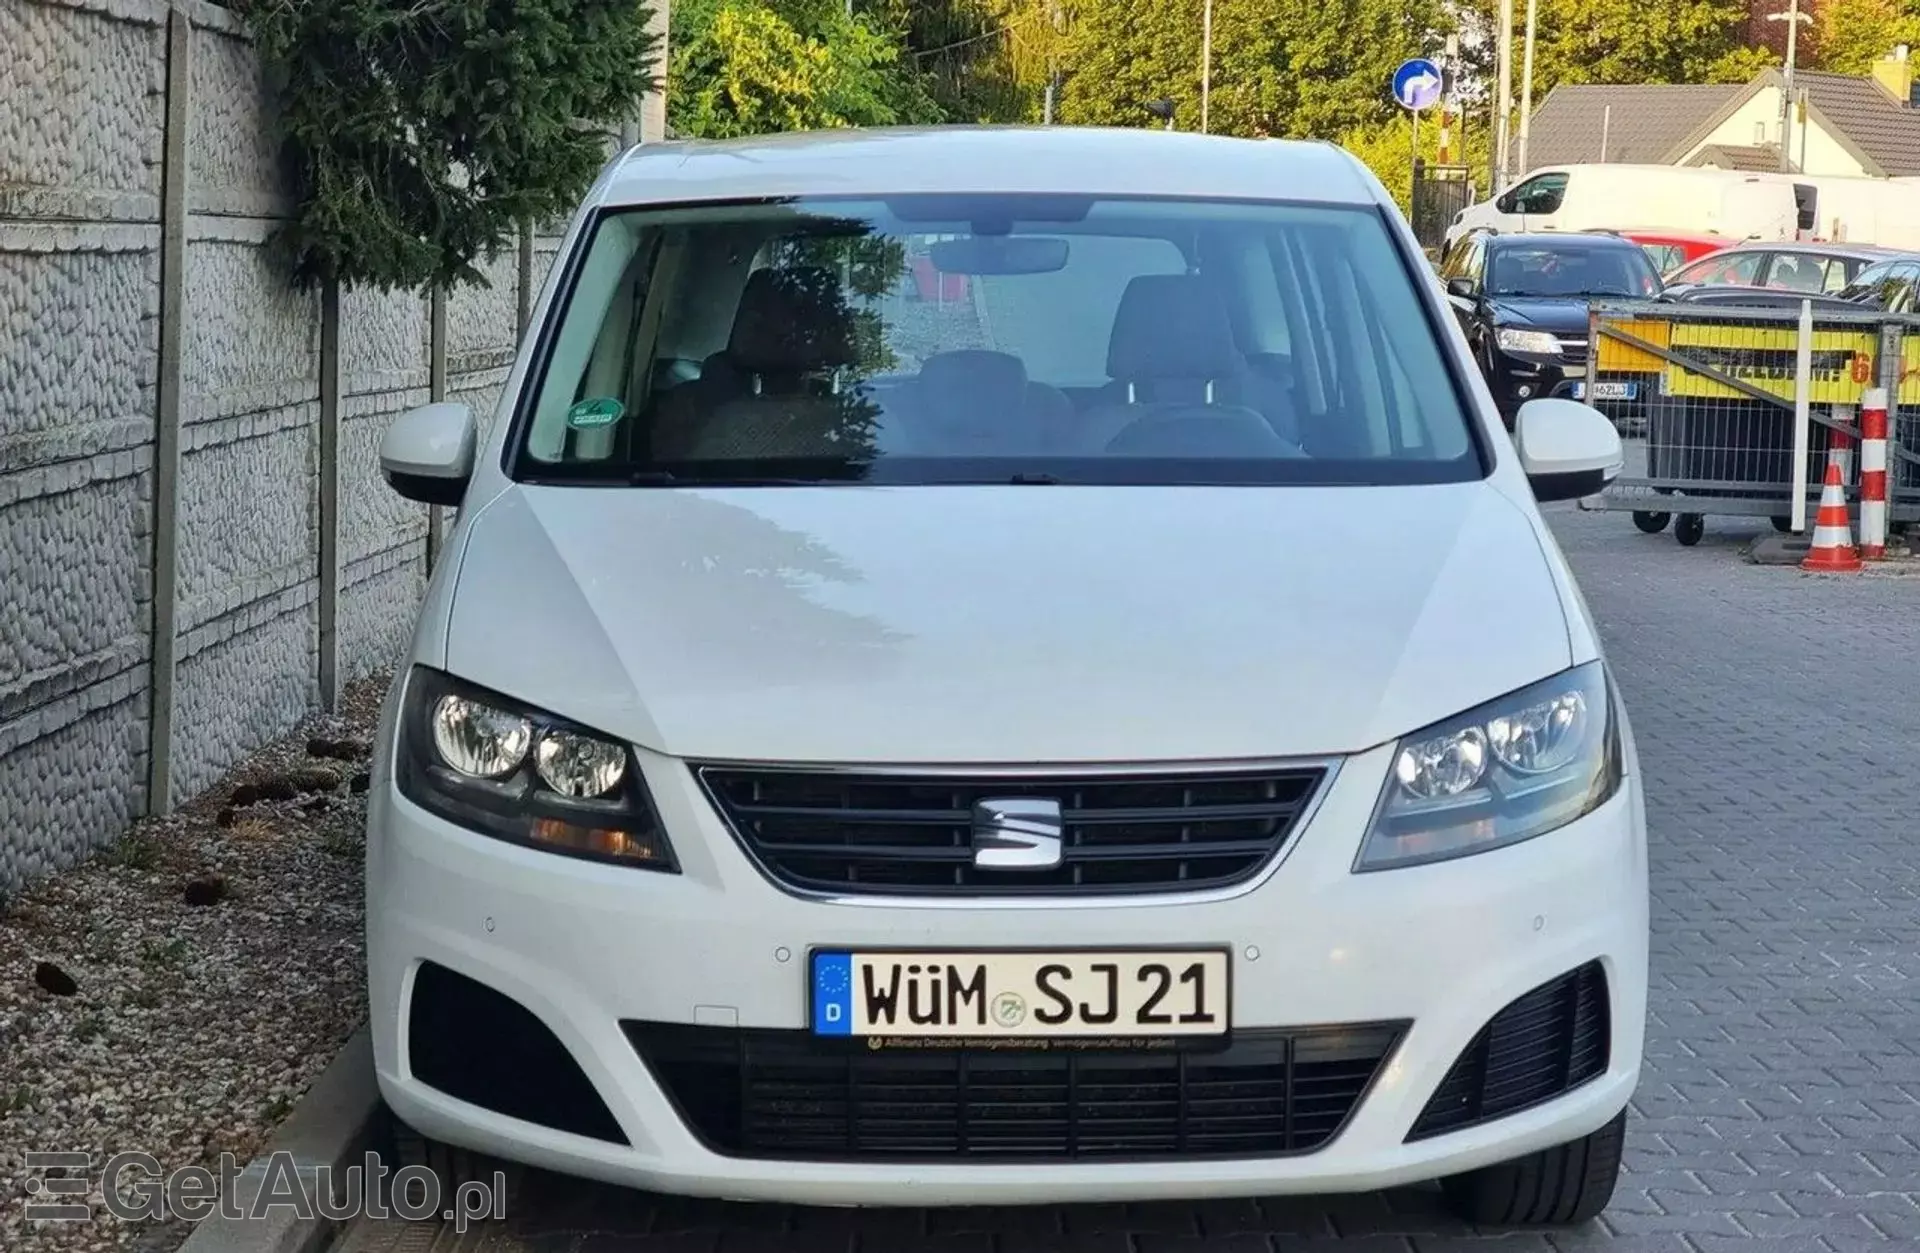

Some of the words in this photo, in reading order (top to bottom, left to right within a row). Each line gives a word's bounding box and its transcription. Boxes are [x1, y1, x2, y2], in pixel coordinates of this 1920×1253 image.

[825, 1003, 841, 1021] D
[1033, 963, 1119, 1026] SJ
[1136, 962, 1216, 1025] 21
